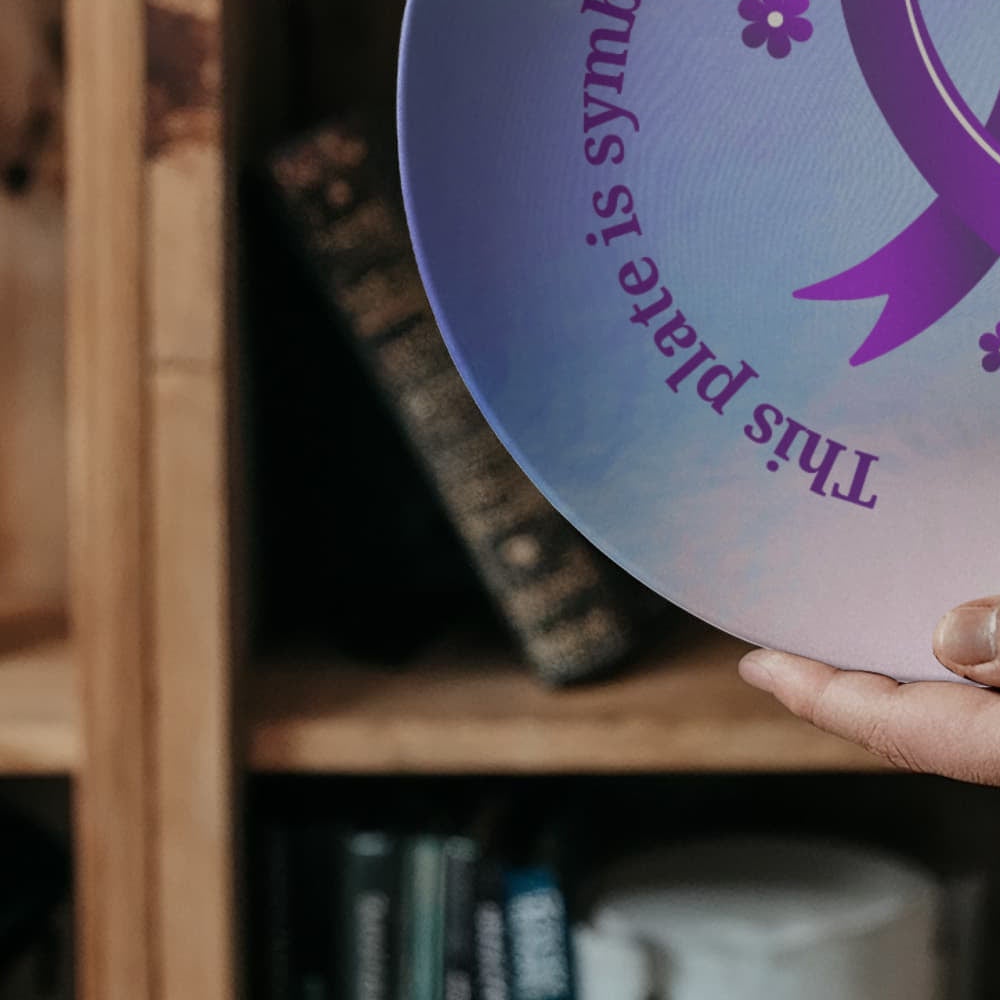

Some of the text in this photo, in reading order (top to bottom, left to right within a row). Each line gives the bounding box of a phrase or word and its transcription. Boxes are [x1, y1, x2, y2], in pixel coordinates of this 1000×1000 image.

[584, 184, 642, 247] is
[617, 255, 759, 415] plate
[743, 402, 879, 510] This
